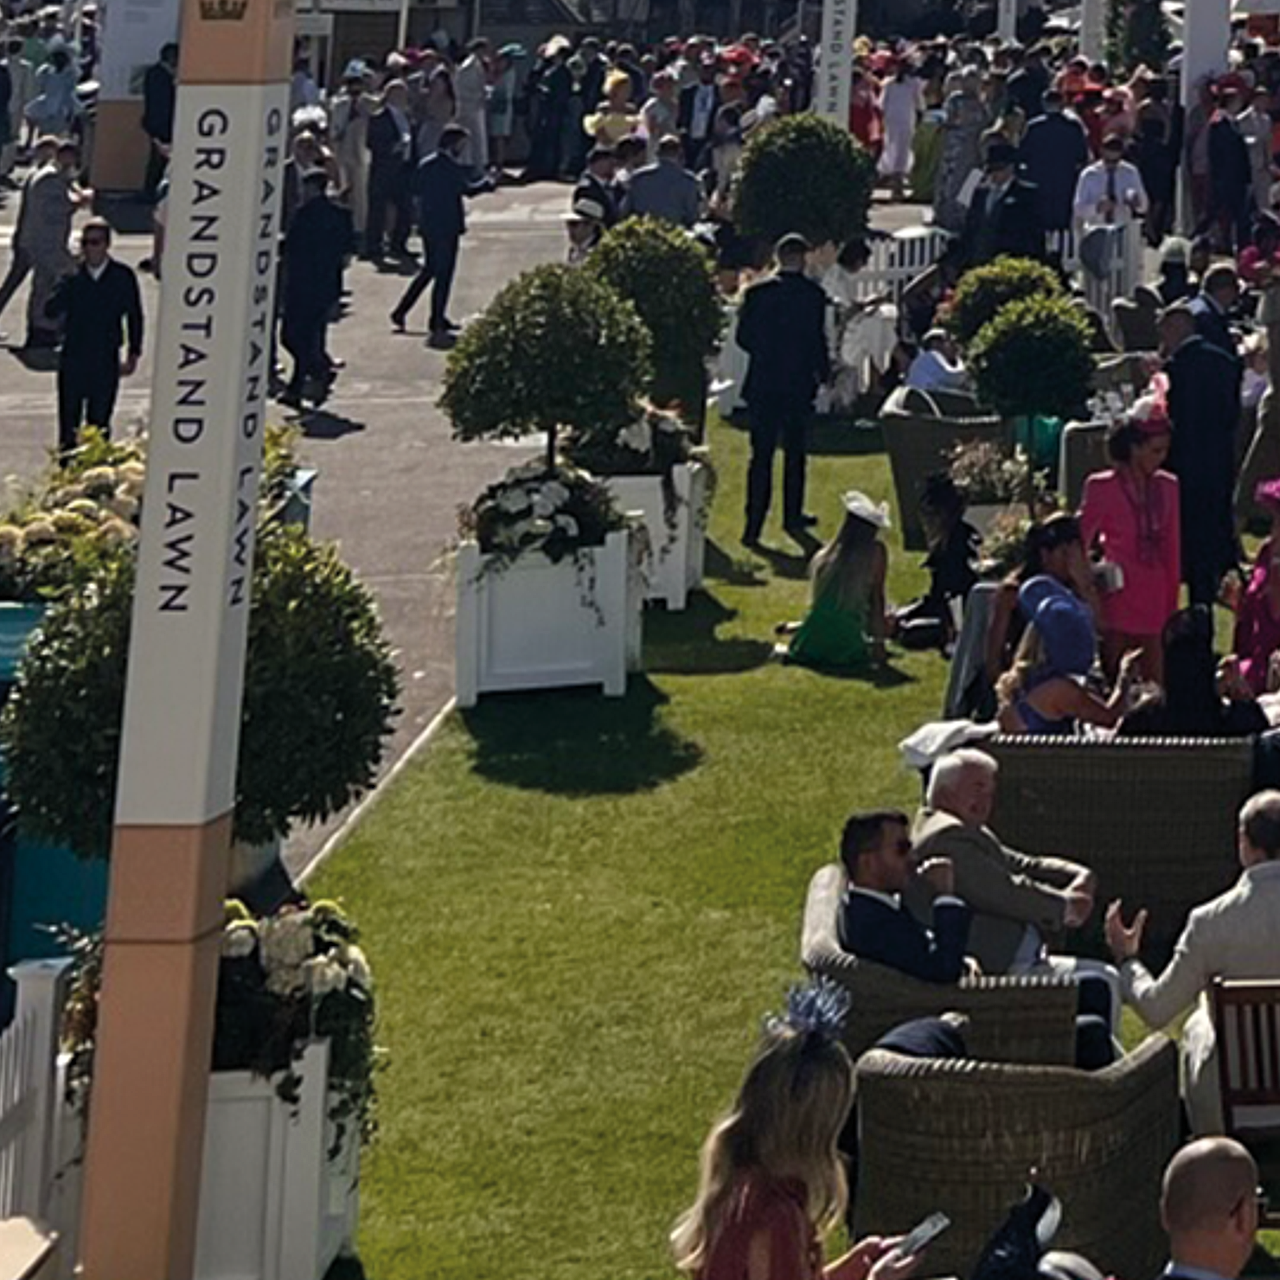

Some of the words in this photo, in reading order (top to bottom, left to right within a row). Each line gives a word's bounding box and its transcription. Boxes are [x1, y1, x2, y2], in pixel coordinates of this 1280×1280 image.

[827, 62, 840, 113] LAWN
[172, 108, 229, 444] GRANDSTAND
[243, 108, 281, 440] GRANDSTAND
[158, 473, 200, 612] LAWN
[229, 466, 254, 607] LAWN
